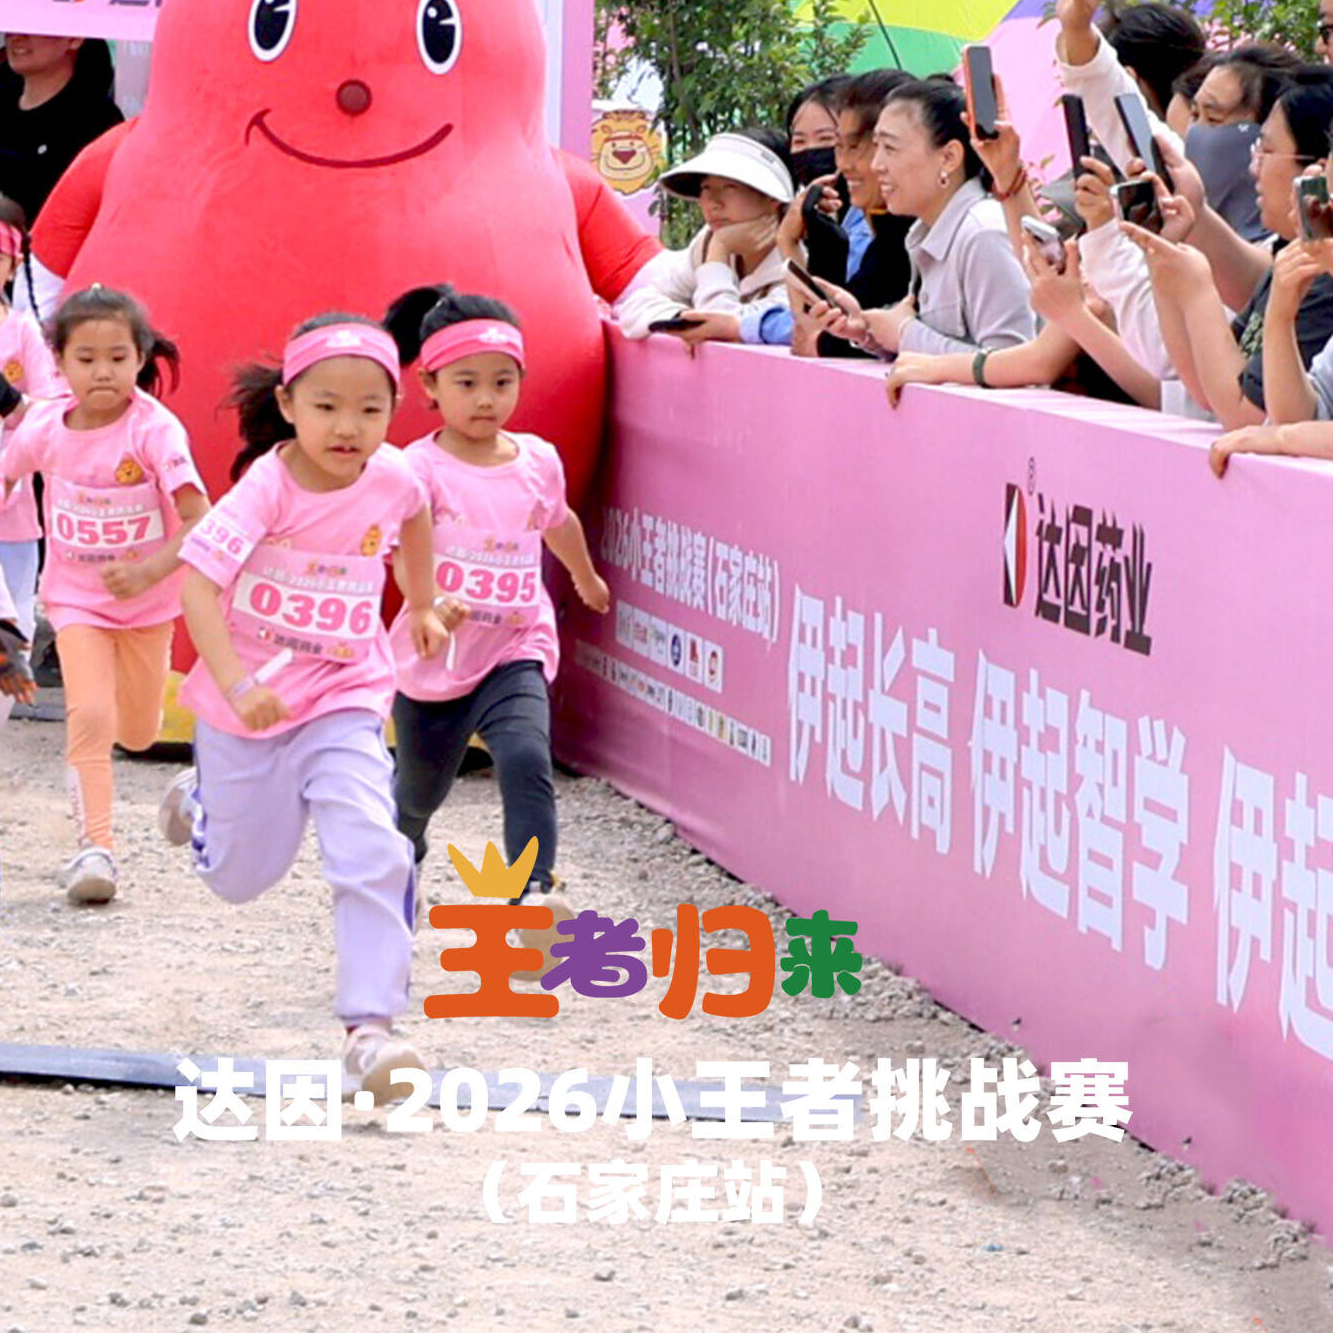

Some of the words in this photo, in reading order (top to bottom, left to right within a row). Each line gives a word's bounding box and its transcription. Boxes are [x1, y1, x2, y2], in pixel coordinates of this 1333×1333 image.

[57, 512, 151, 545] 0557
[436, 561, 536, 603] 0395
[1035, 493, 1153, 656] 达因药业
[250, 582, 372, 634] 0396
[788, 583, 955, 854] 伊起长高
[968, 649, 1189, 970] 伊起智学
